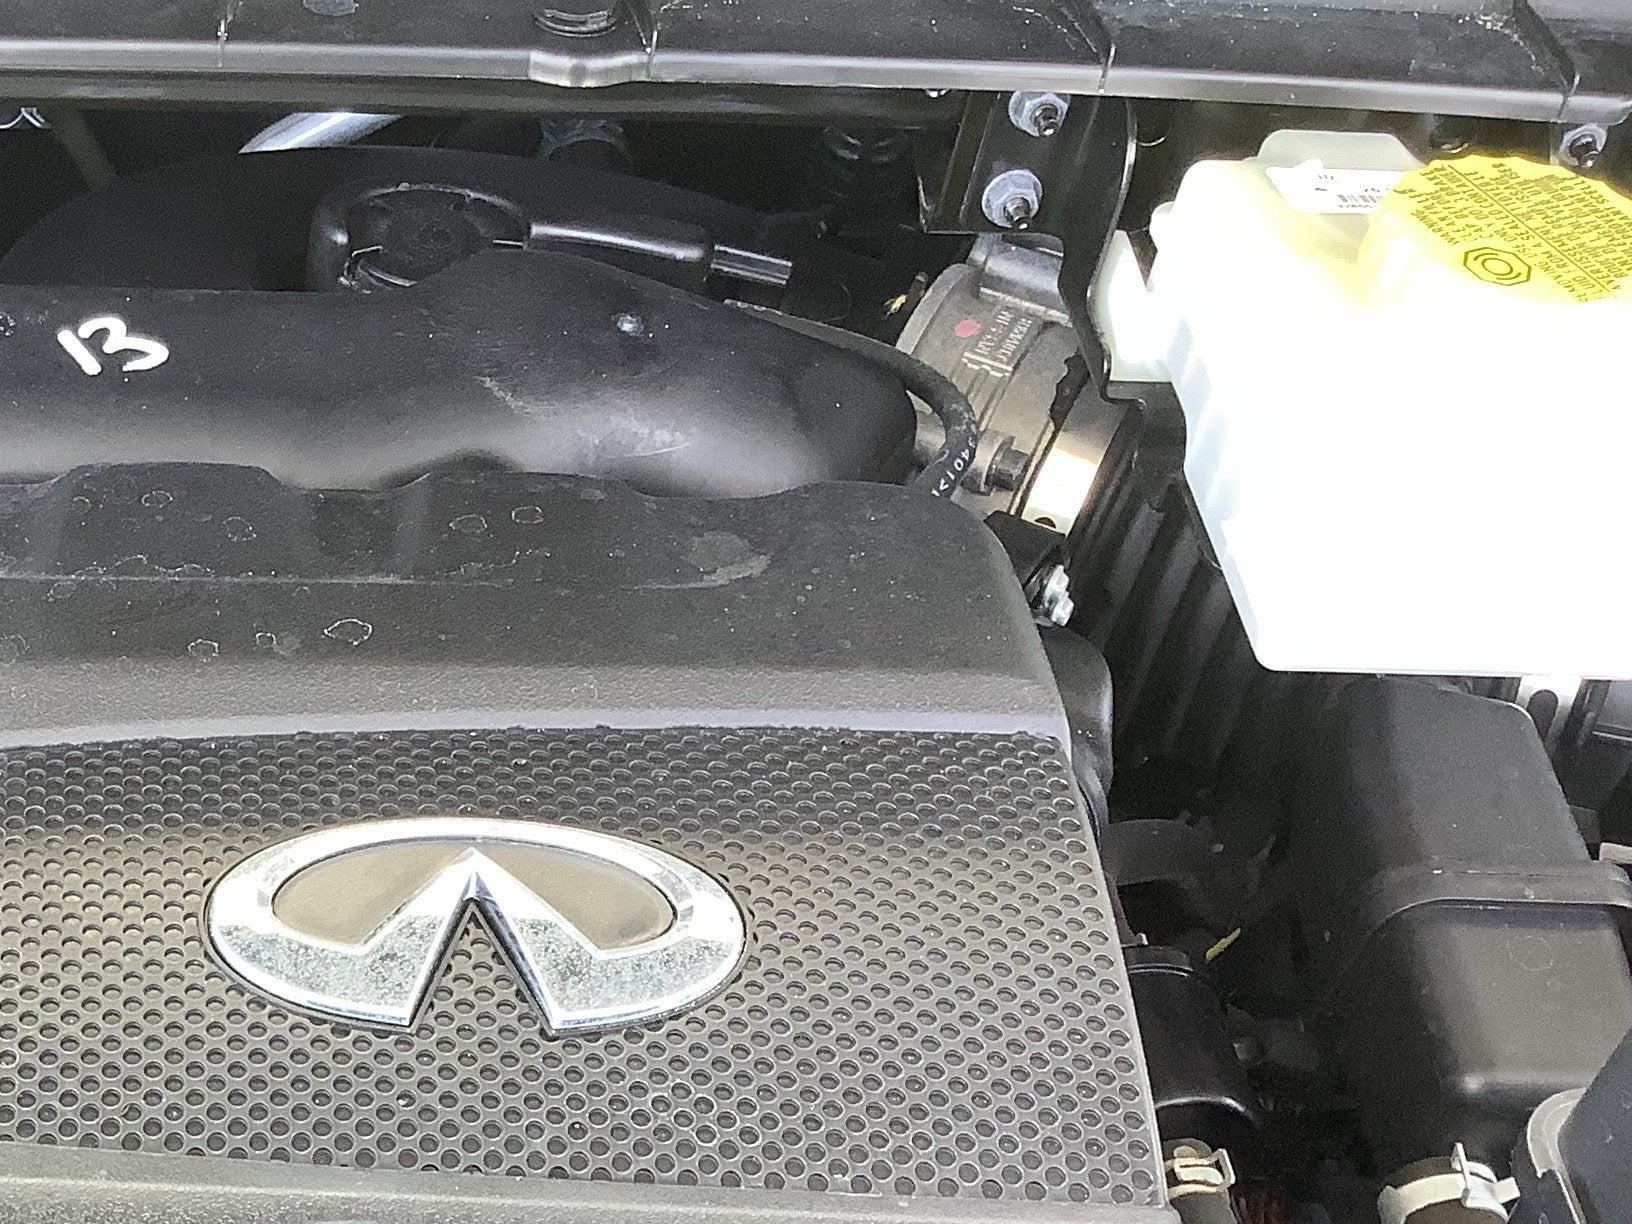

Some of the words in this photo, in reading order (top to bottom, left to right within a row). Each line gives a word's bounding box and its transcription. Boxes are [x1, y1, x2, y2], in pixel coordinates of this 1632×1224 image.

[1485, 208, 1537, 241] SEALED
[1538, 249, 1577, 273] FROM
[57, 317, 170, 376] 13
